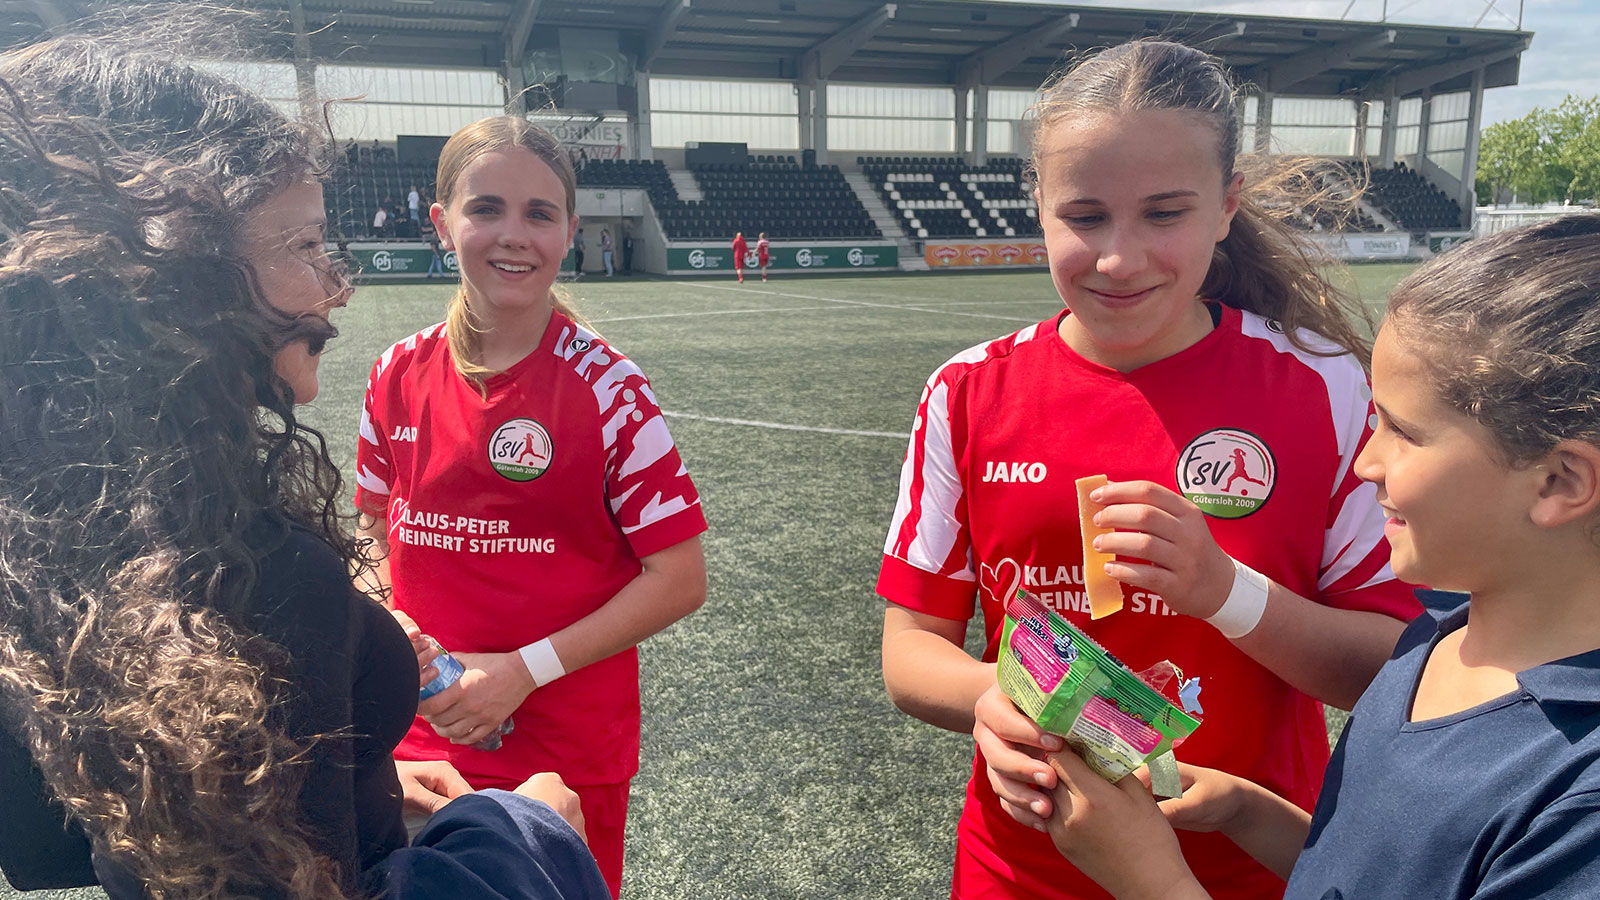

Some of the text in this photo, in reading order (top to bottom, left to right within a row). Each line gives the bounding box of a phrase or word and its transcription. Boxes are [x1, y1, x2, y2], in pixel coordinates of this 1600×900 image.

[390, 425, 418, 443] JA
[496, 463, 539, 475] Gütersloh 2009
[982, 461, 1047, 483] JAKO
[1192, 495, 1256, 508] Gütersloh 2009
[399, 526, 555, 554] REINERT STIFTUNG
[1024, 564, 1085, 586] KLAU
